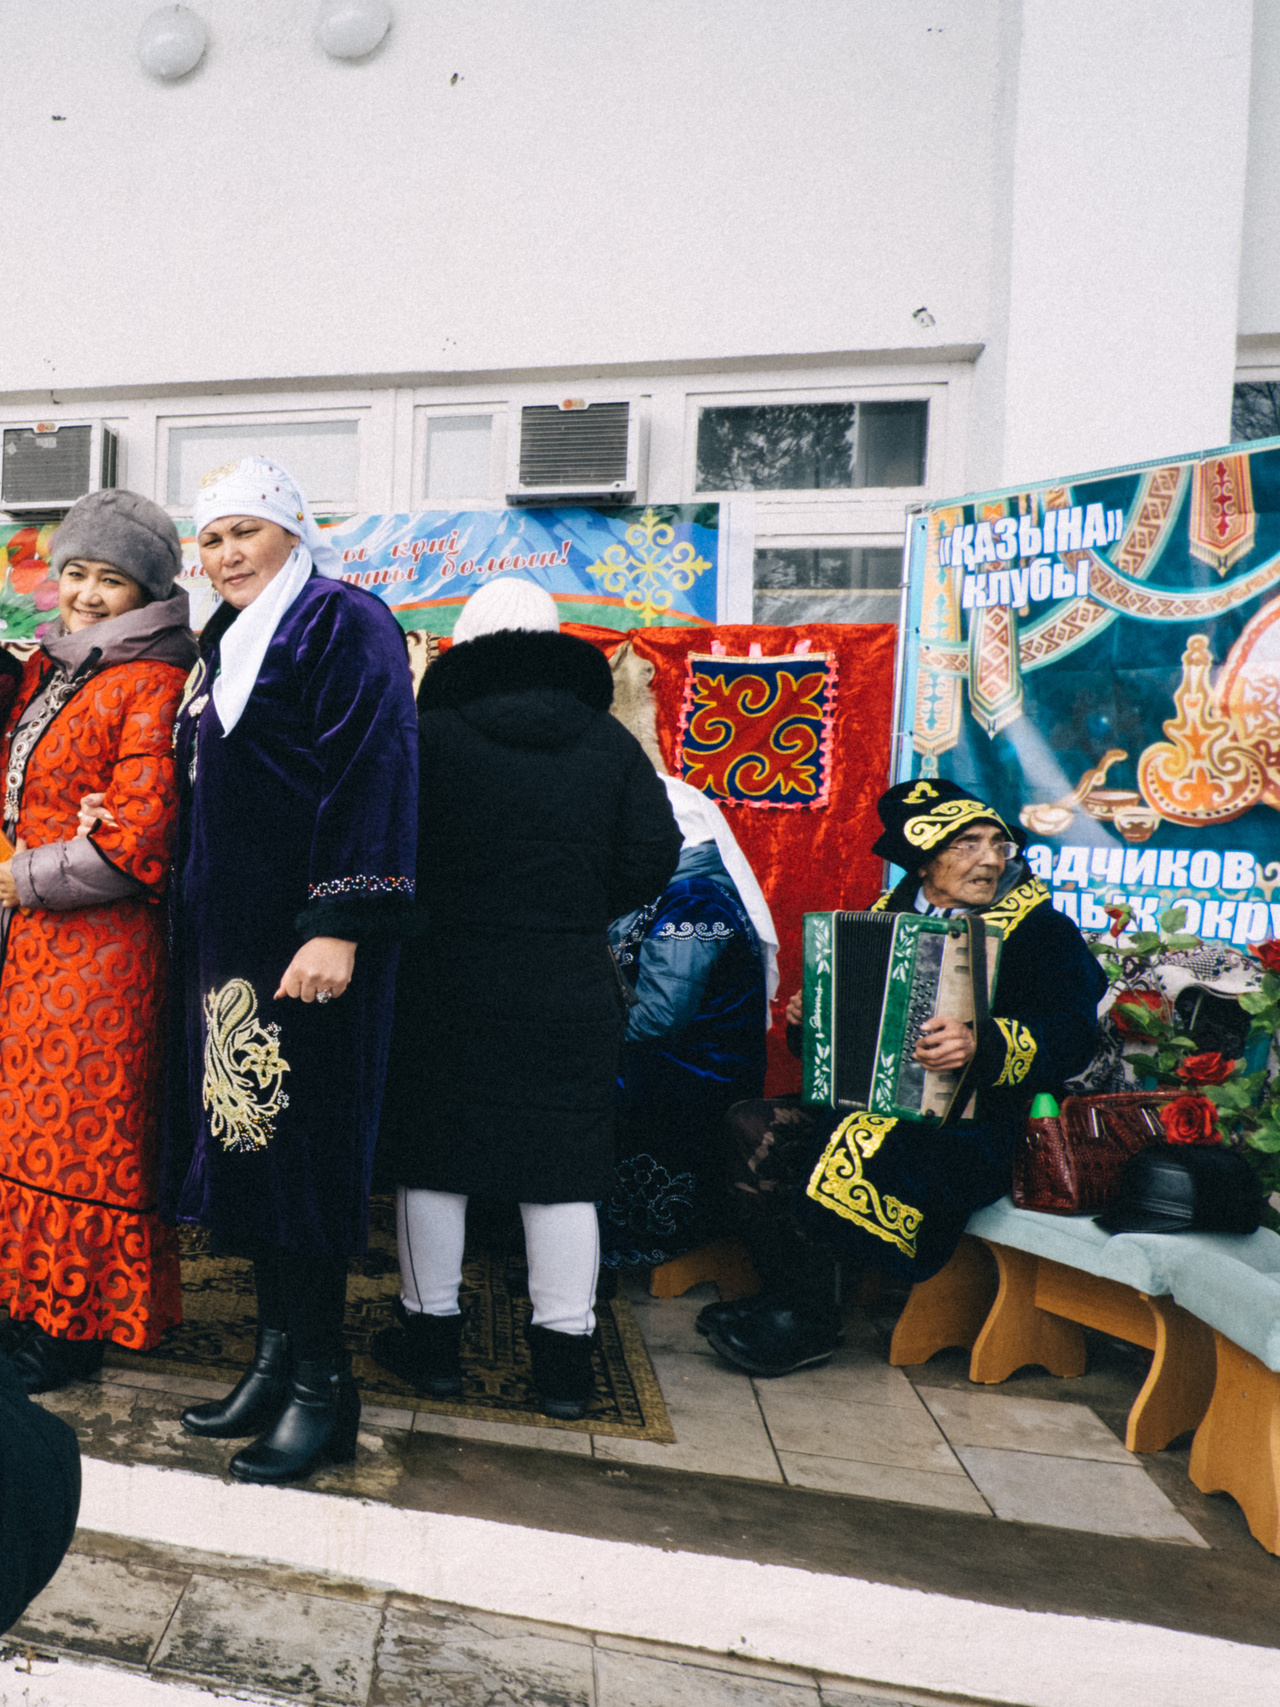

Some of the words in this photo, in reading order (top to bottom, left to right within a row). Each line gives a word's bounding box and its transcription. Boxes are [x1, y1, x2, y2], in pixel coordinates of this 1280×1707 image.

[441, 540, 571, 577] болсын!
[962, 557, 1090, 609] клубы
[1022, 844, 1256, 889] адчиков
